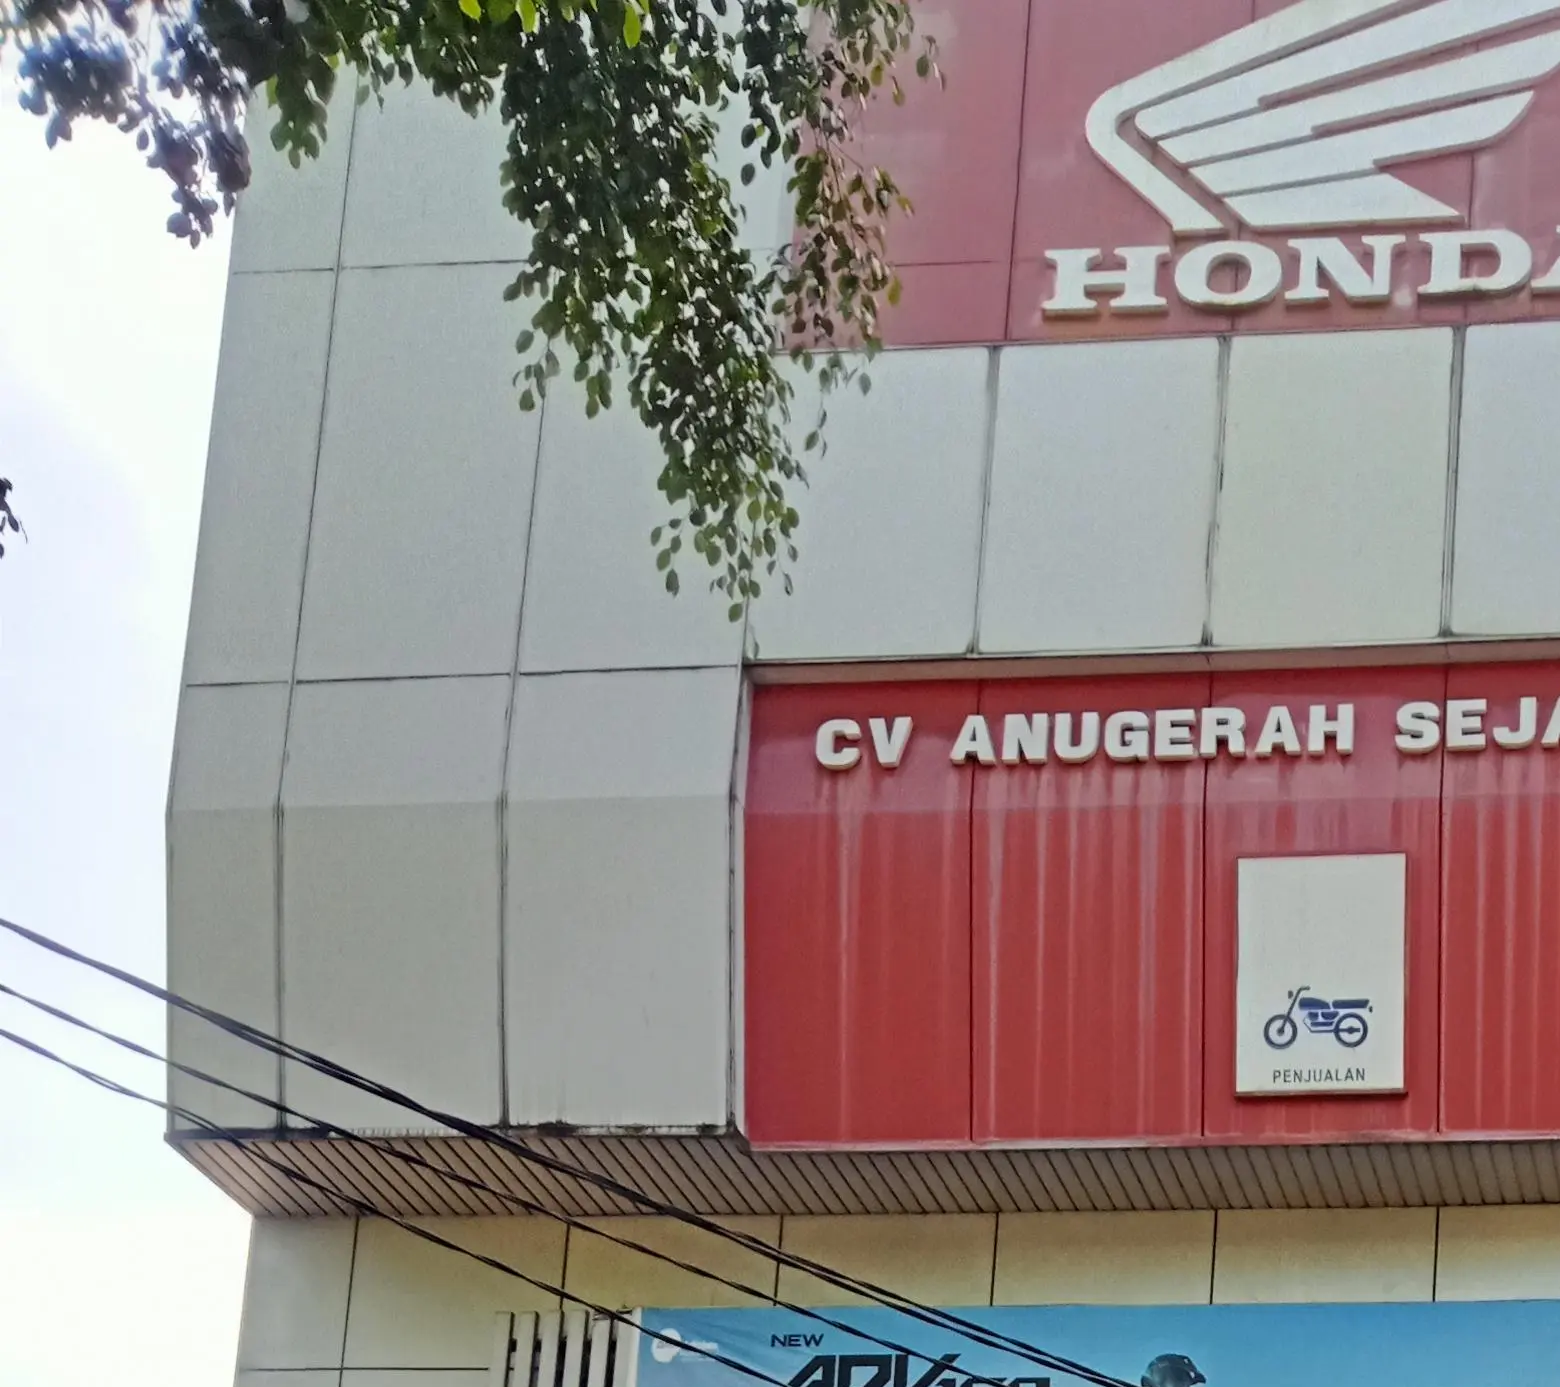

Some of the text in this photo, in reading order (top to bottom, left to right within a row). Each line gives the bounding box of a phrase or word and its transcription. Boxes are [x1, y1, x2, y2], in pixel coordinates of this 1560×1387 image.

[814, 714, 913, 771] CV
[950, 701, 1356, 768] ANUGERAH
[1271, 1065, 1368, 1085] PENJUALAN
[770, 1333, 824, 1348] NEW
